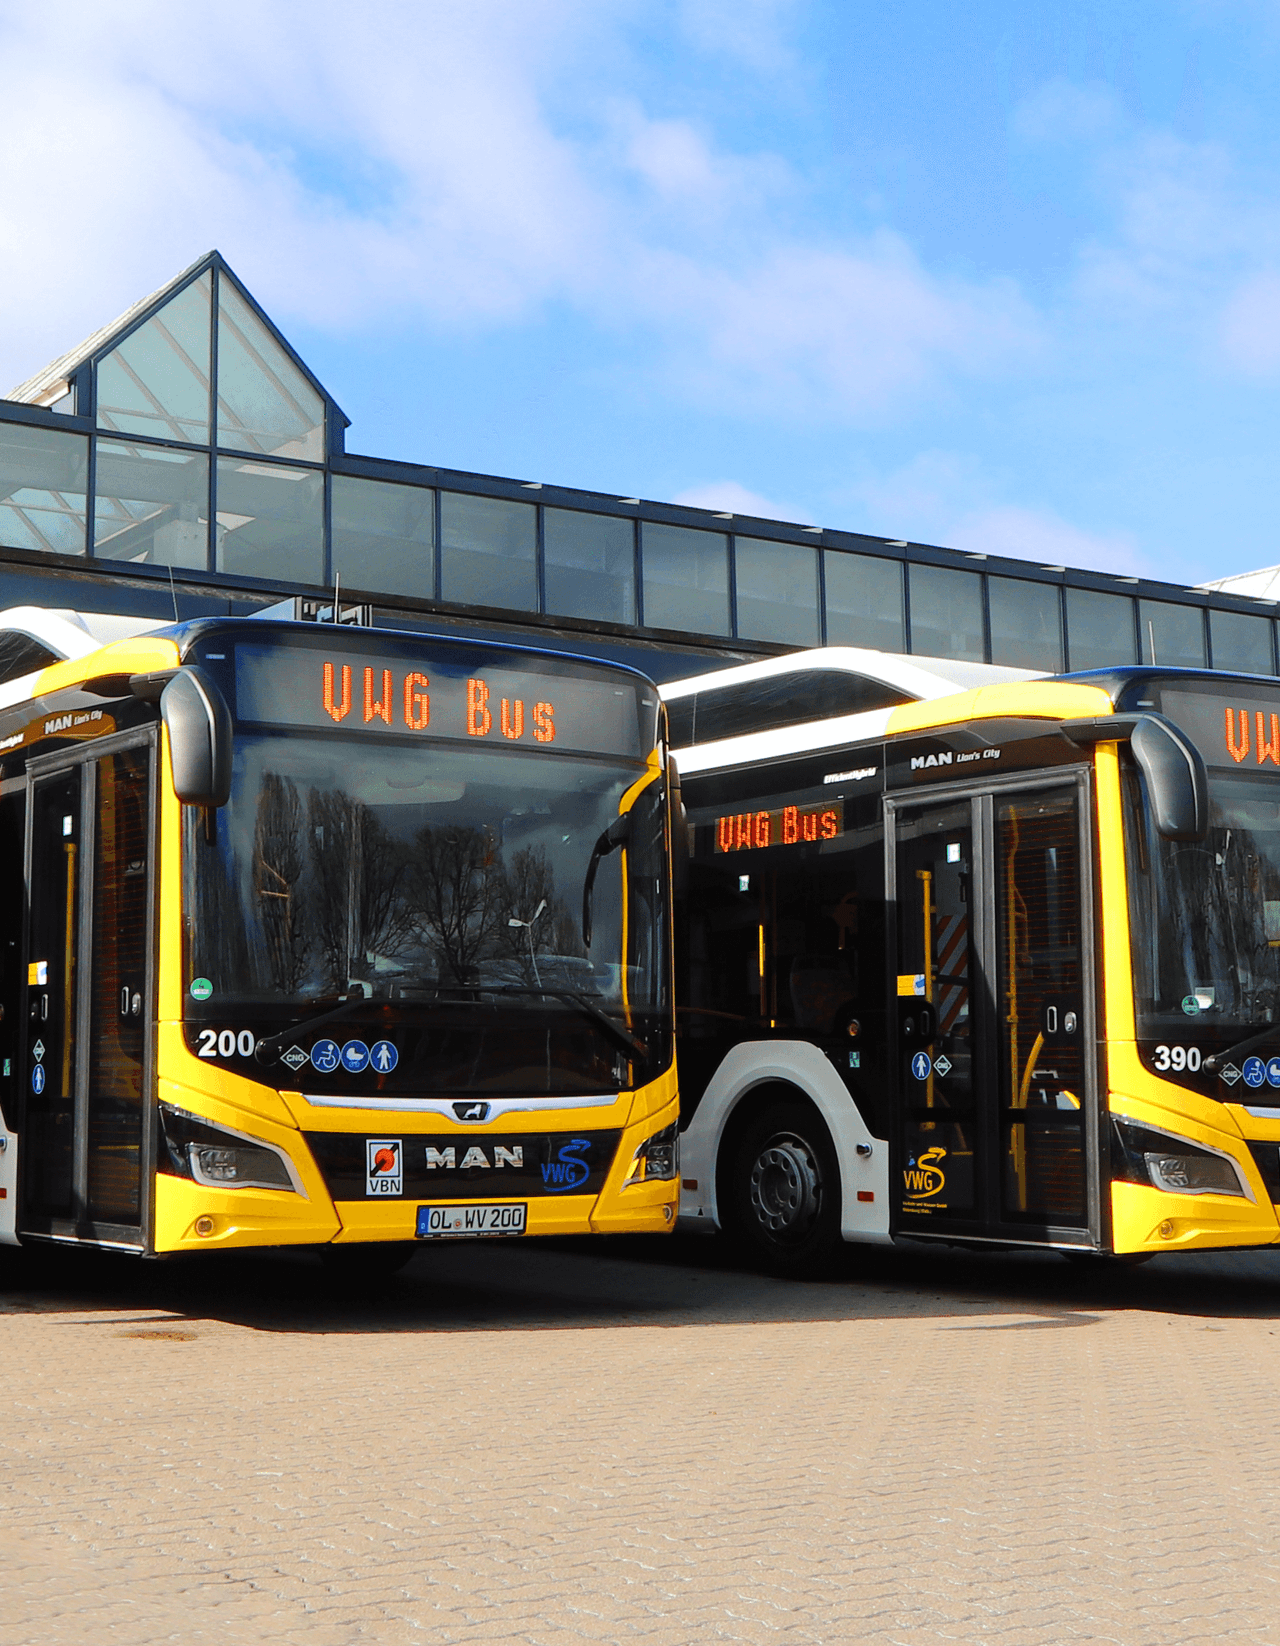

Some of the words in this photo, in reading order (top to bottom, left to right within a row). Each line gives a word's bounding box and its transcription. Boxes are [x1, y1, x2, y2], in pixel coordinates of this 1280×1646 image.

[322, 661, 430, 731] VWG
[466, 677, 556, 743] Bus
[44, 714, 73, 734] MAN
[910, 751, 953, 770] MAN
[956, 752, 981, 763] Lion's
[983, 749, 1001, 759] City
[719, 811, 770, 853] VWG
[782, 805, 838, 845] Bus
[197, 1029, 255, 1057] 200
[286, 1053, 305, 1062] CNG
[1154, 1045, 1201, 1072] 390
[1223, 1070, 1238, 1078] CNG
[425, 1146, 524, 1169] MAN
[541, 1163, 576, 1183] VWG
[903, 1170, 933, 1191] VWG
[370, 1179, 401, 1193] VBN
[430, 1210, 452, 1229] OL
[465, 1209, 487, 1228] WV
[490, 1208, 523, 1228] 200
